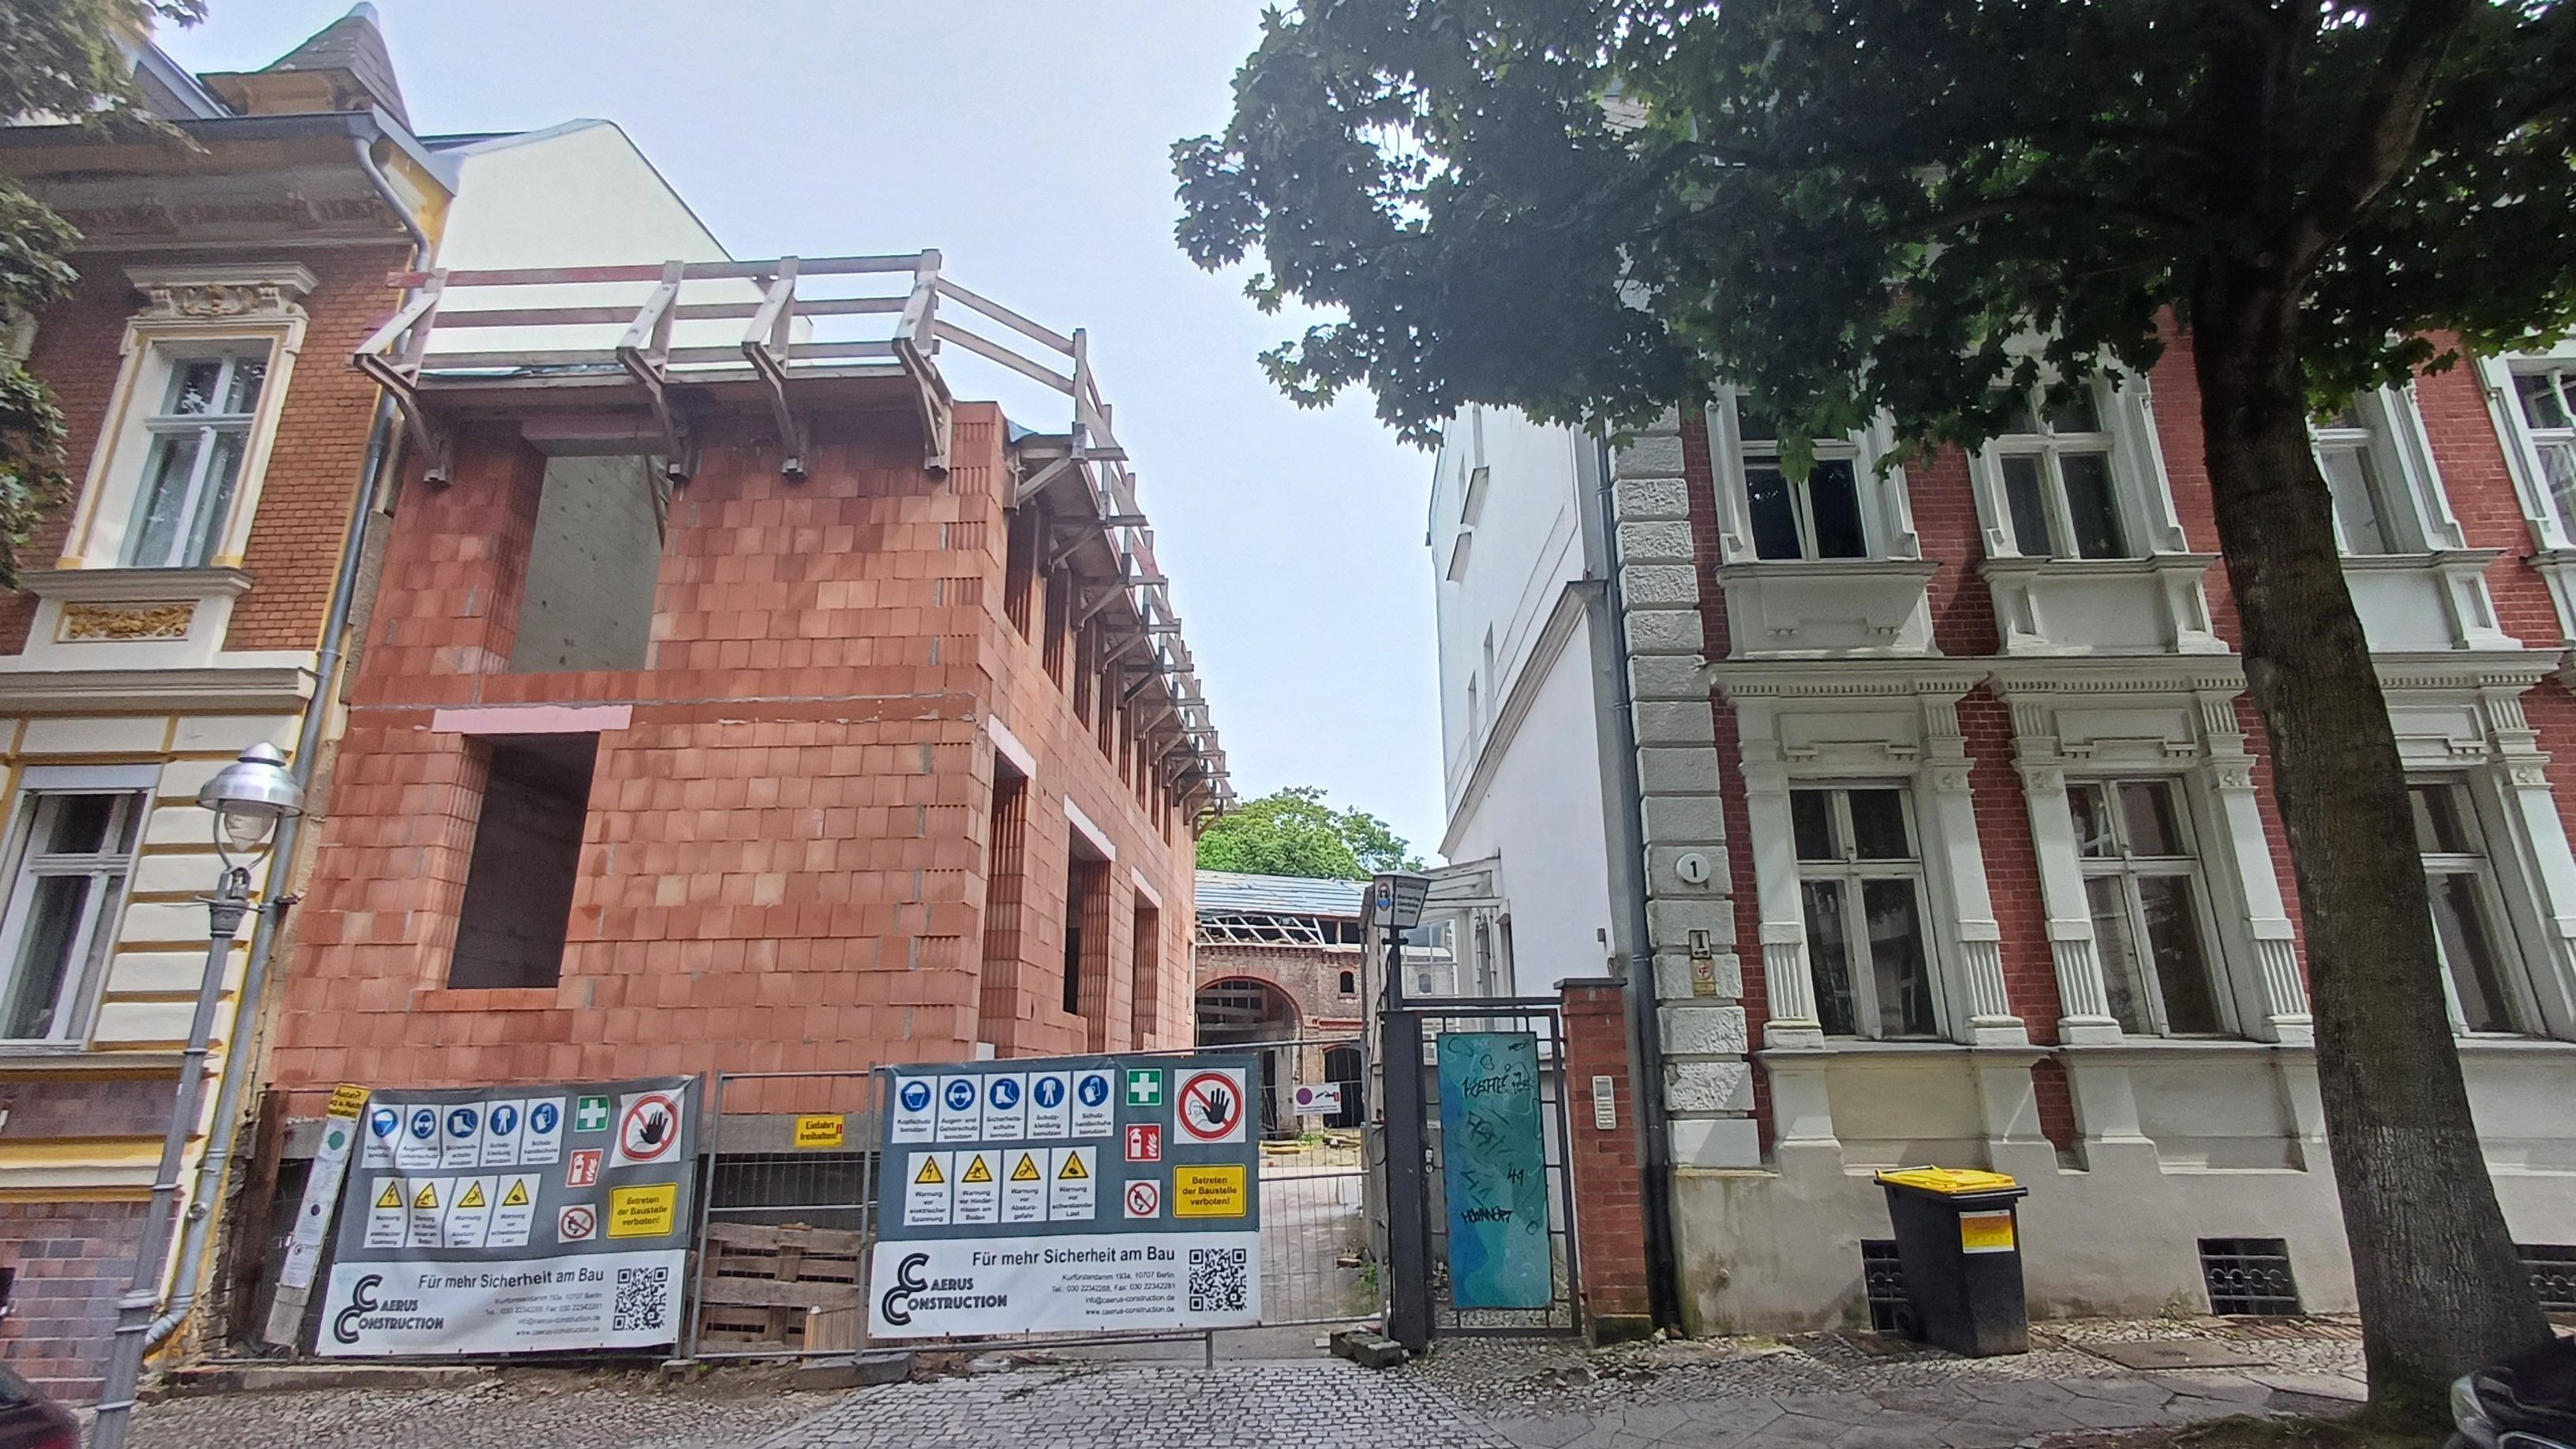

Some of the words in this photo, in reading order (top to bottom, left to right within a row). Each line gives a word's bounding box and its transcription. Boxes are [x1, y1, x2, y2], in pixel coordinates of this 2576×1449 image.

[1690, 860, 1698, 878] 1
[1696, 933, 1705, 949] 1
[1198, 1186, 1237, 1195] Baustelle
[627, 1196, 660, 1205] Betreten
[631, 1206, 668, 1215] Baustelle
[622, 1216, 660, 1226] verboten!
[972, 1251, 998, 1266] Für
[1002, 1250, 1039, 1265] mehr
[1044, 1247, 1116, 1264] Sicherheit
[1120, 1249, 1142, 1261] am
[1147, 1245, 1175, 1261] Bau
[418, 1274, 442, 1289] Für
[444, 1275, 477, 1288] mehr
[481, 1271, 552, 1289] Sicherheit
[556, 1271, 575, 1282] am
[578, 1267, 604, 1282] Bau
